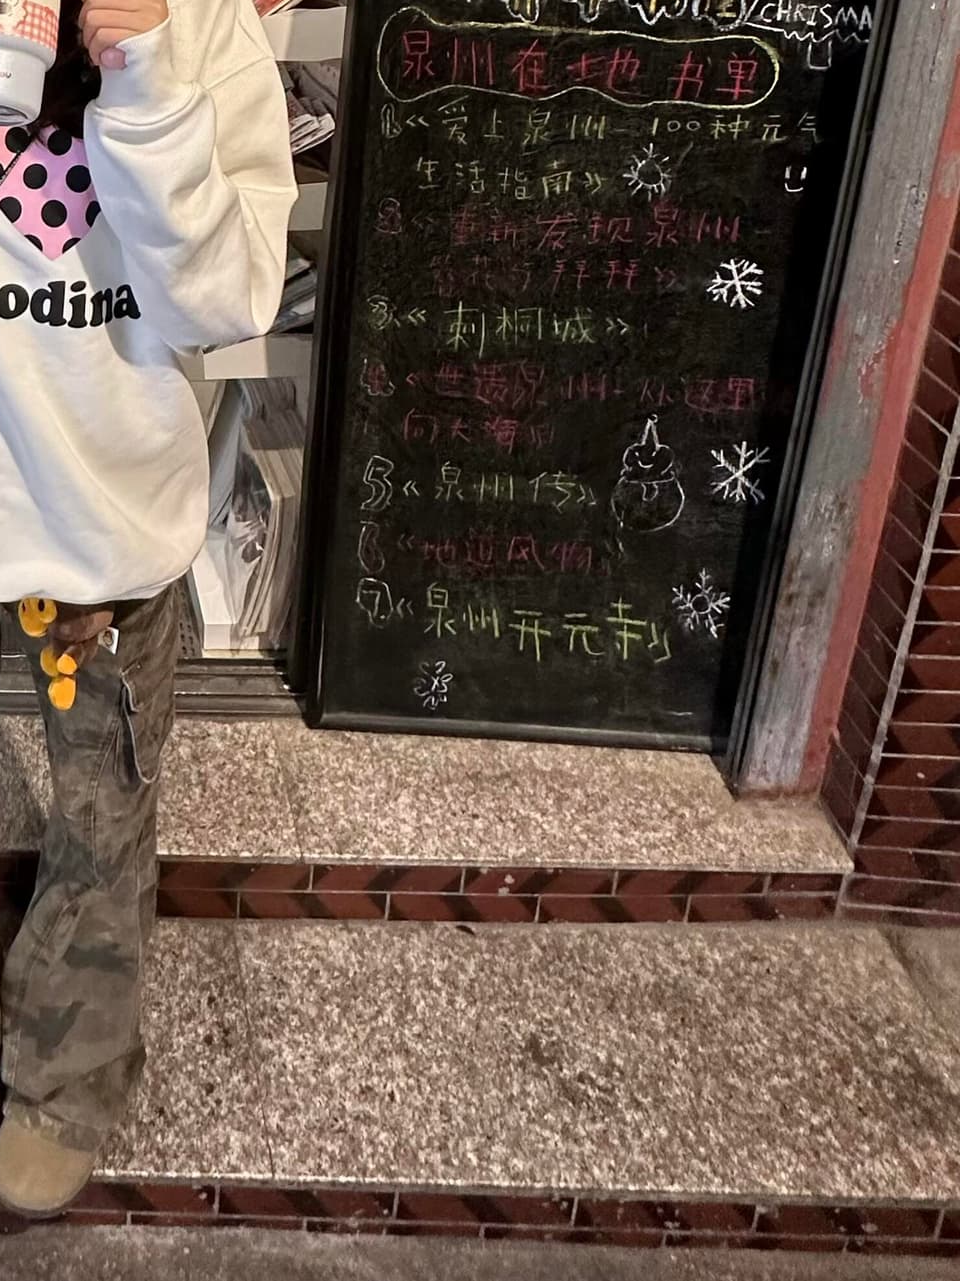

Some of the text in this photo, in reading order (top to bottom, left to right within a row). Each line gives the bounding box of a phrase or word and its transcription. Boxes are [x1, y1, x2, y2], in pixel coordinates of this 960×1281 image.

[401, 30, 760, 101] 泉州在地书单
